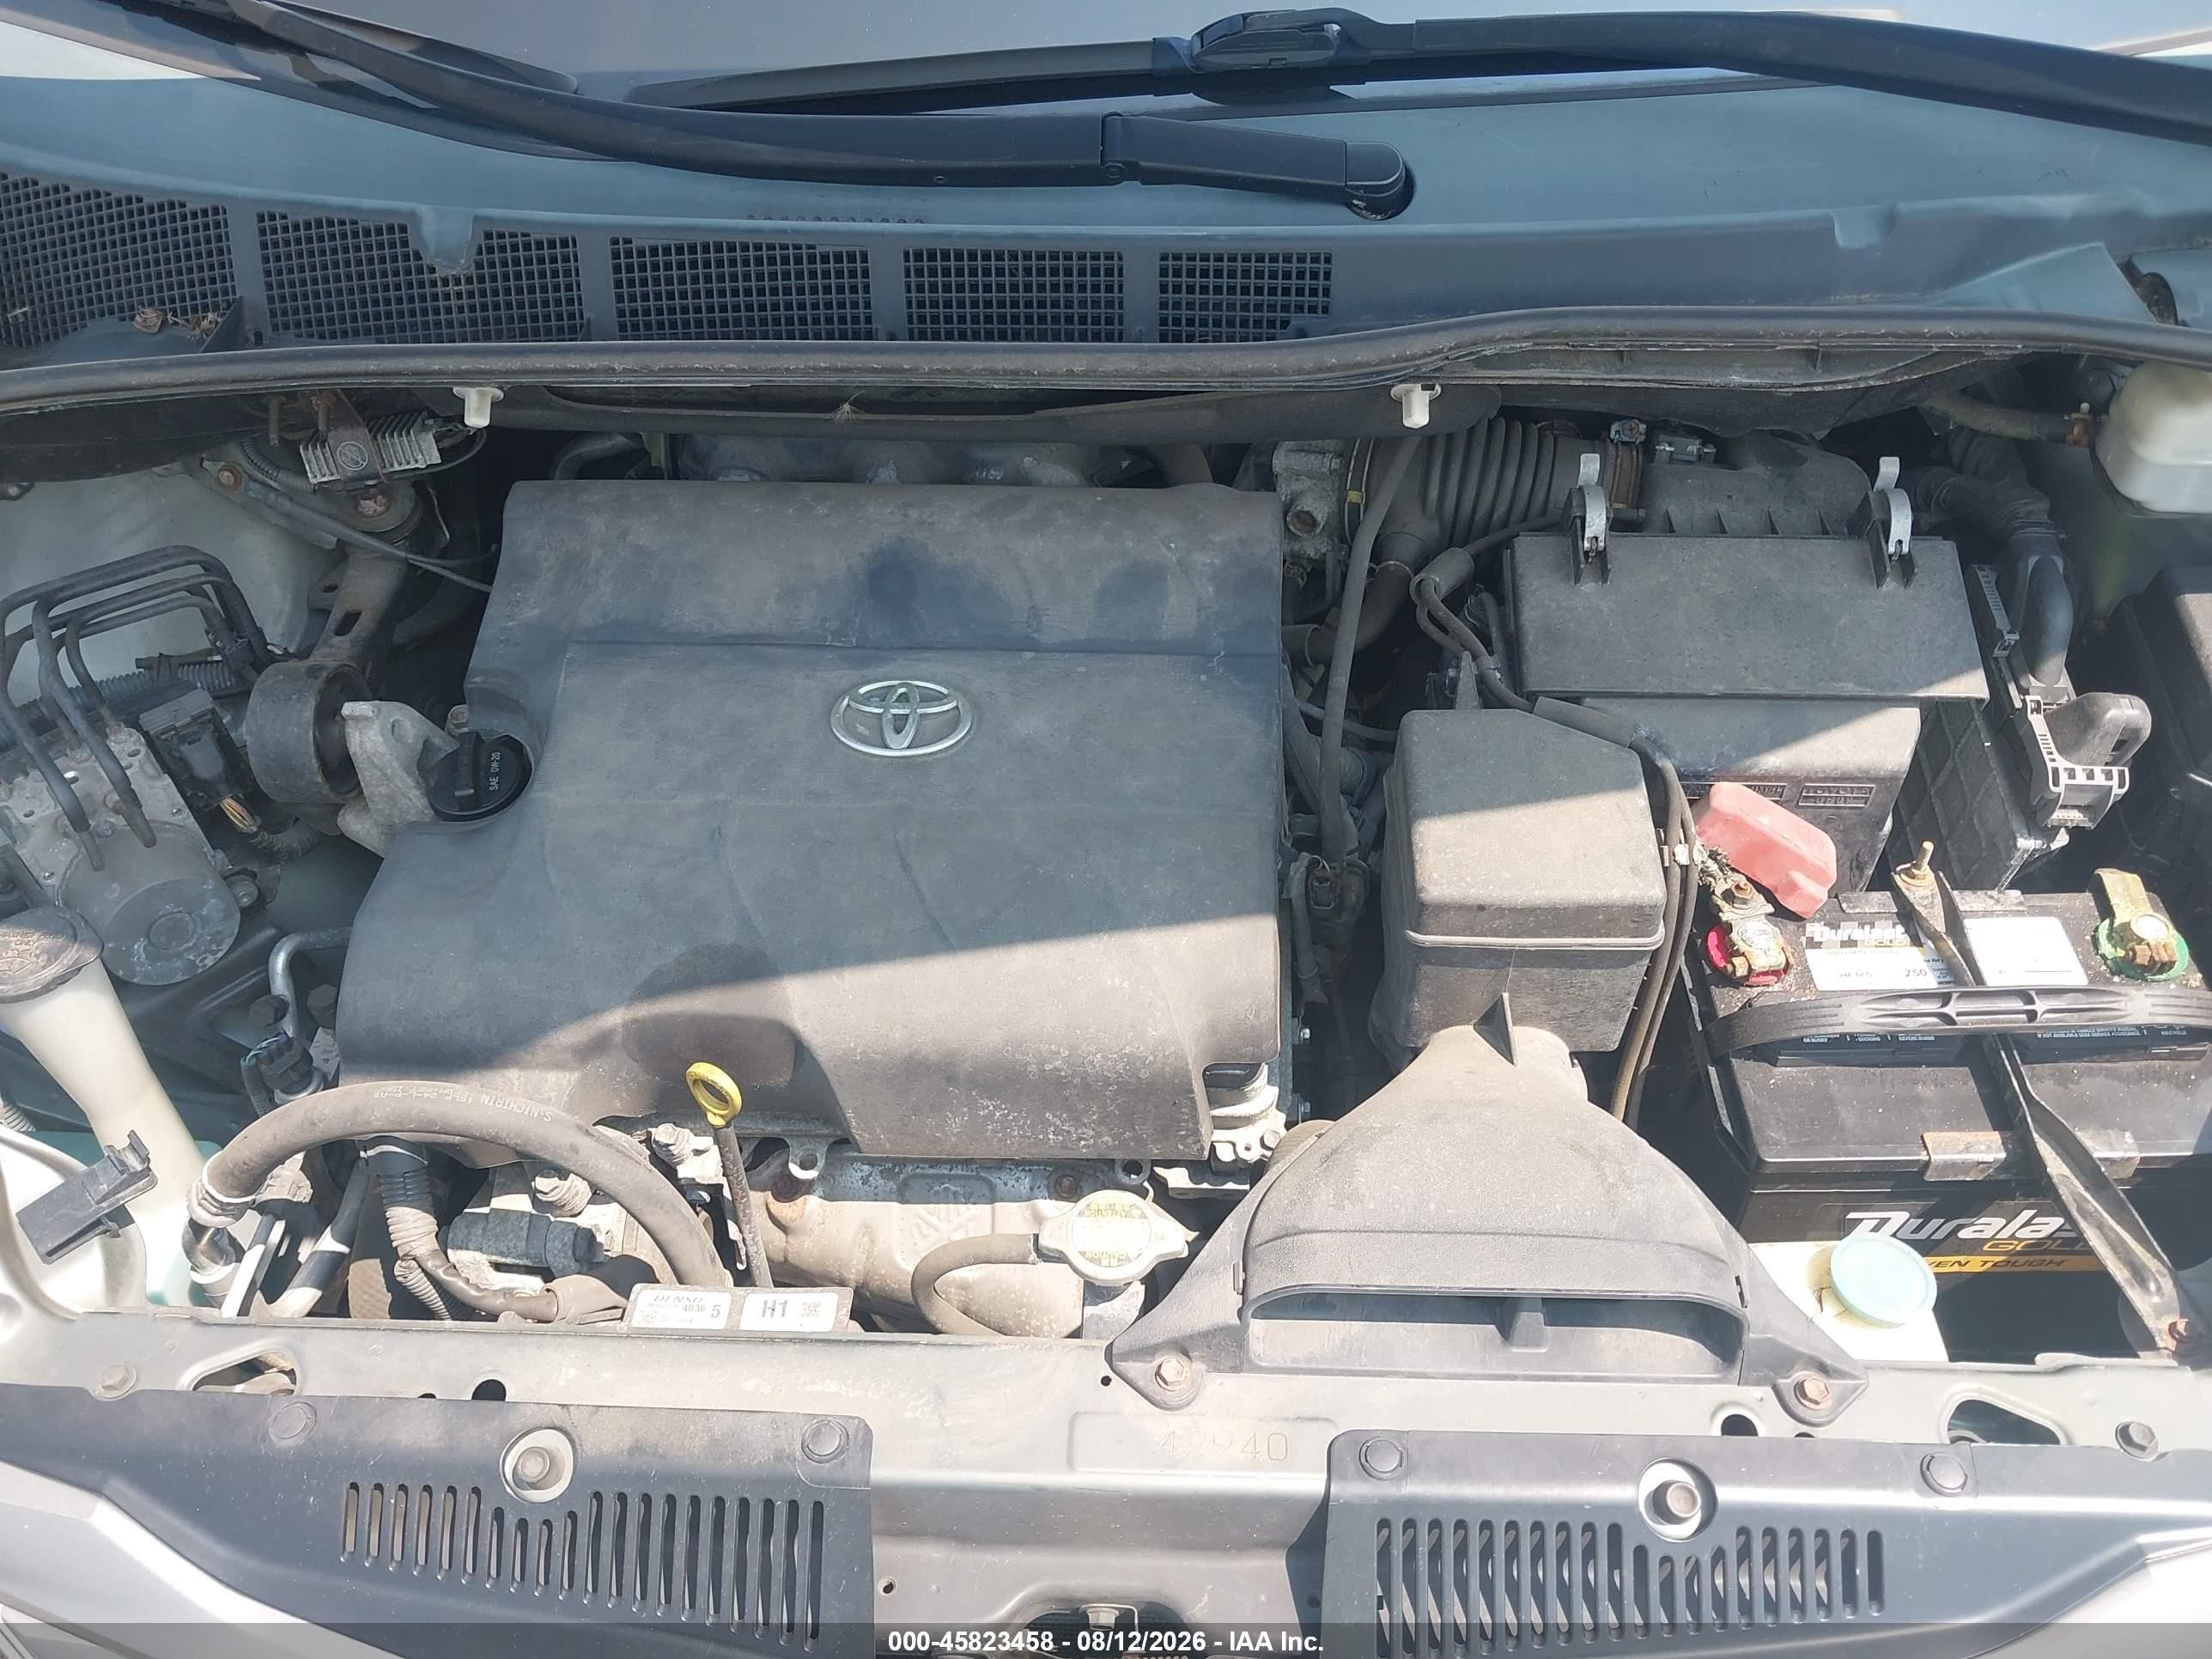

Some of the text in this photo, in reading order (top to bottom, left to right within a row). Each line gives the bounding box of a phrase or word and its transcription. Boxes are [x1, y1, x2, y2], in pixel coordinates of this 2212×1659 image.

[489, 751, 501, 791] SAE 0W-20
[1905, 969, 1928, 977] 750
[1845, 1209, 2079, 1240] Durala
[1085, 1250, 1127, 1259] CAUTION
[1978, 1260, 2069, 1268] TOUGH
[710, 1304, 722, 1319] 5
[761, 1299, 789, 1318] H1
